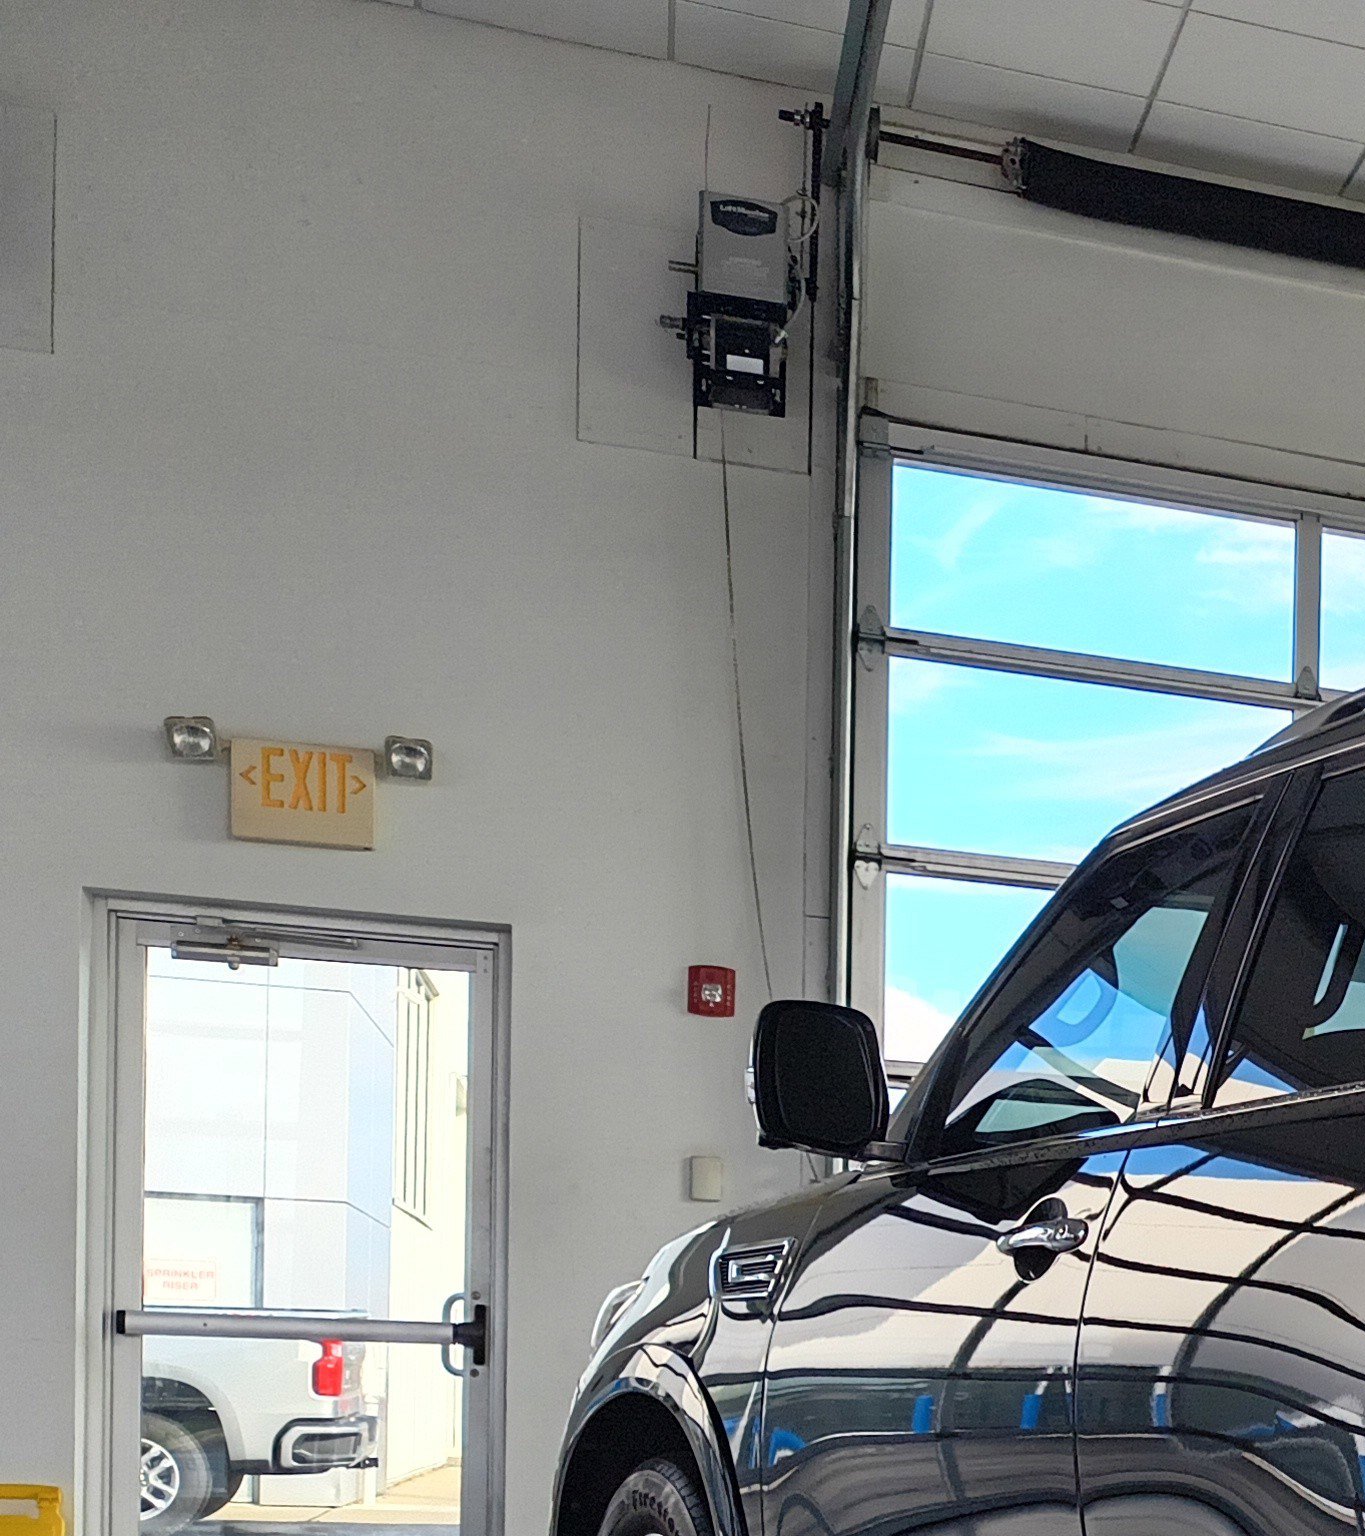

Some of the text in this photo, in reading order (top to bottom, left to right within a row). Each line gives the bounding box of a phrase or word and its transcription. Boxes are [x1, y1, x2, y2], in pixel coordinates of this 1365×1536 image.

[260, 747, 353, 814] EXIT
[146, 1268, 215, 1279] SPRINKLER
[163, 1280, 199, 1291] RISER
